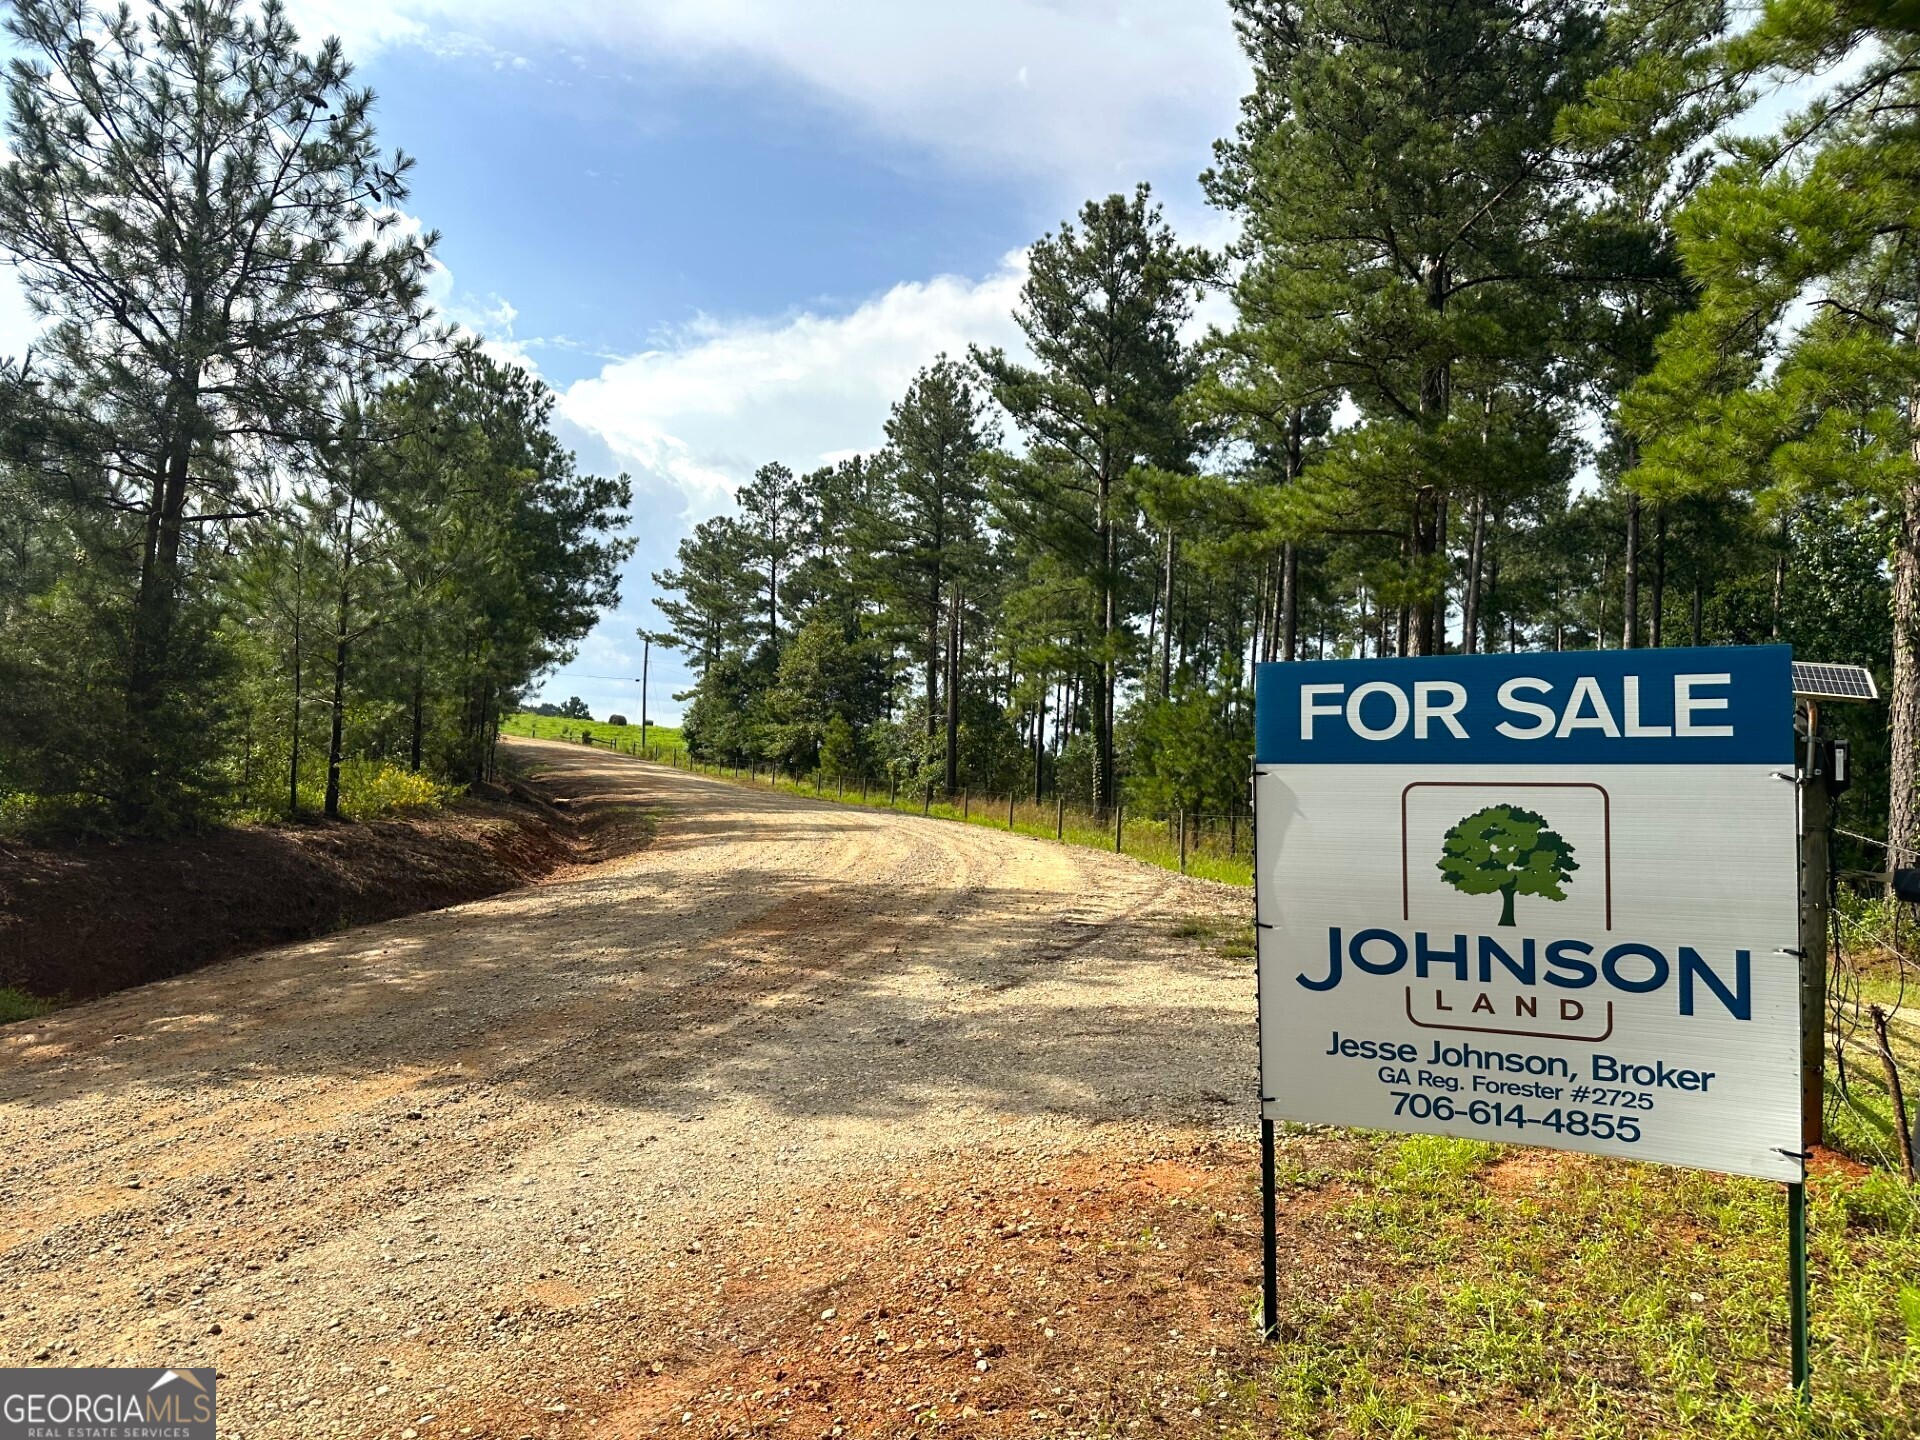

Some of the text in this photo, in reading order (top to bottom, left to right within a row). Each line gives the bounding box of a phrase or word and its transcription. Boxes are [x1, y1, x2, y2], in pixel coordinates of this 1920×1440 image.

[1300, 673, 1735, 741] FOR SALE
[1295, 927, 1752, 1021] JOHNSON
[1435, 989, 1585, 1021] LAND
[1325, 1030, 1716, 1092] Jesse Johnson, Broker
[1377, 1065, 1655, 1111] GA Reg. Forester #2725
[1389, 1090, 1642, 1143] 706-614-4855
